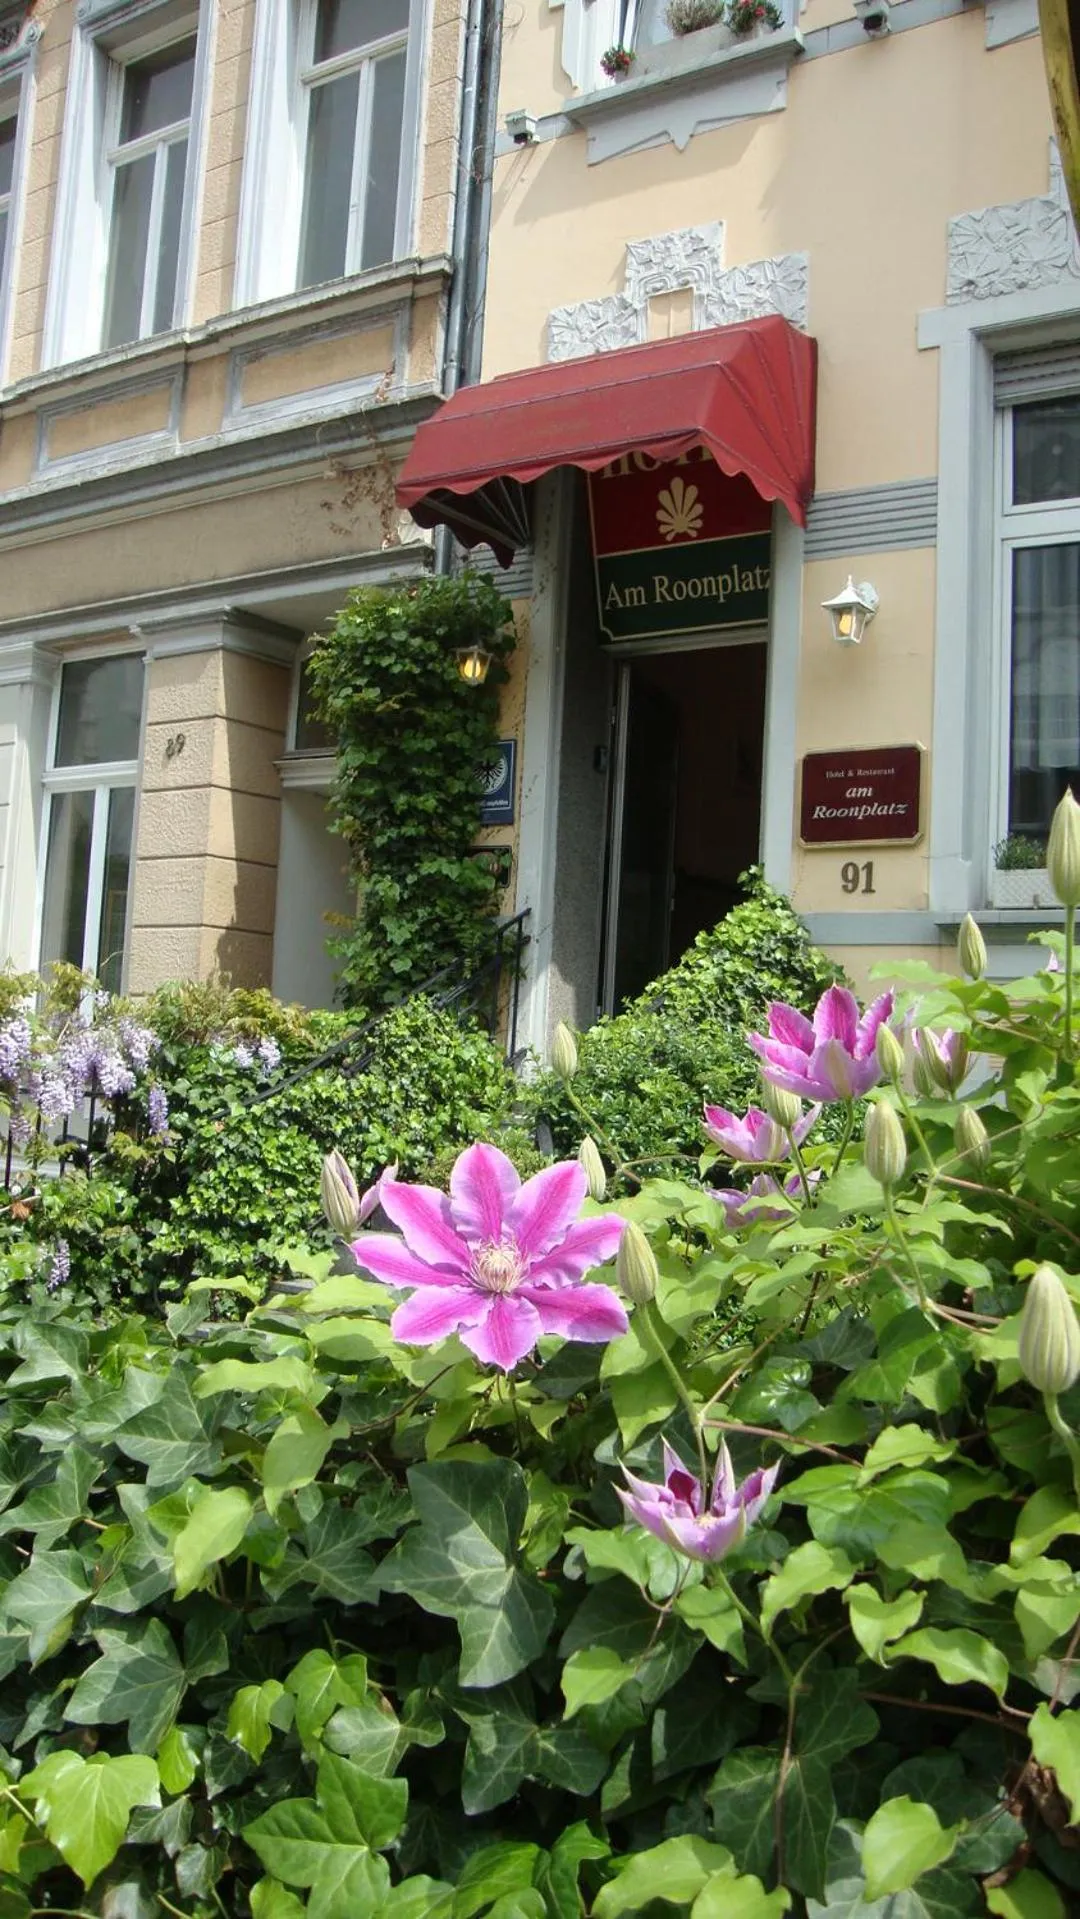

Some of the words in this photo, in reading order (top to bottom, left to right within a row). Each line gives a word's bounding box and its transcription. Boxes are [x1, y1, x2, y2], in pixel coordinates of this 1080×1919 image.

[605, 580, 648, 610] Am
[846, 786, 873, 798] am
[812, 803, 907, 820] Roonplatz
[841, 861, 876, 894] 91
